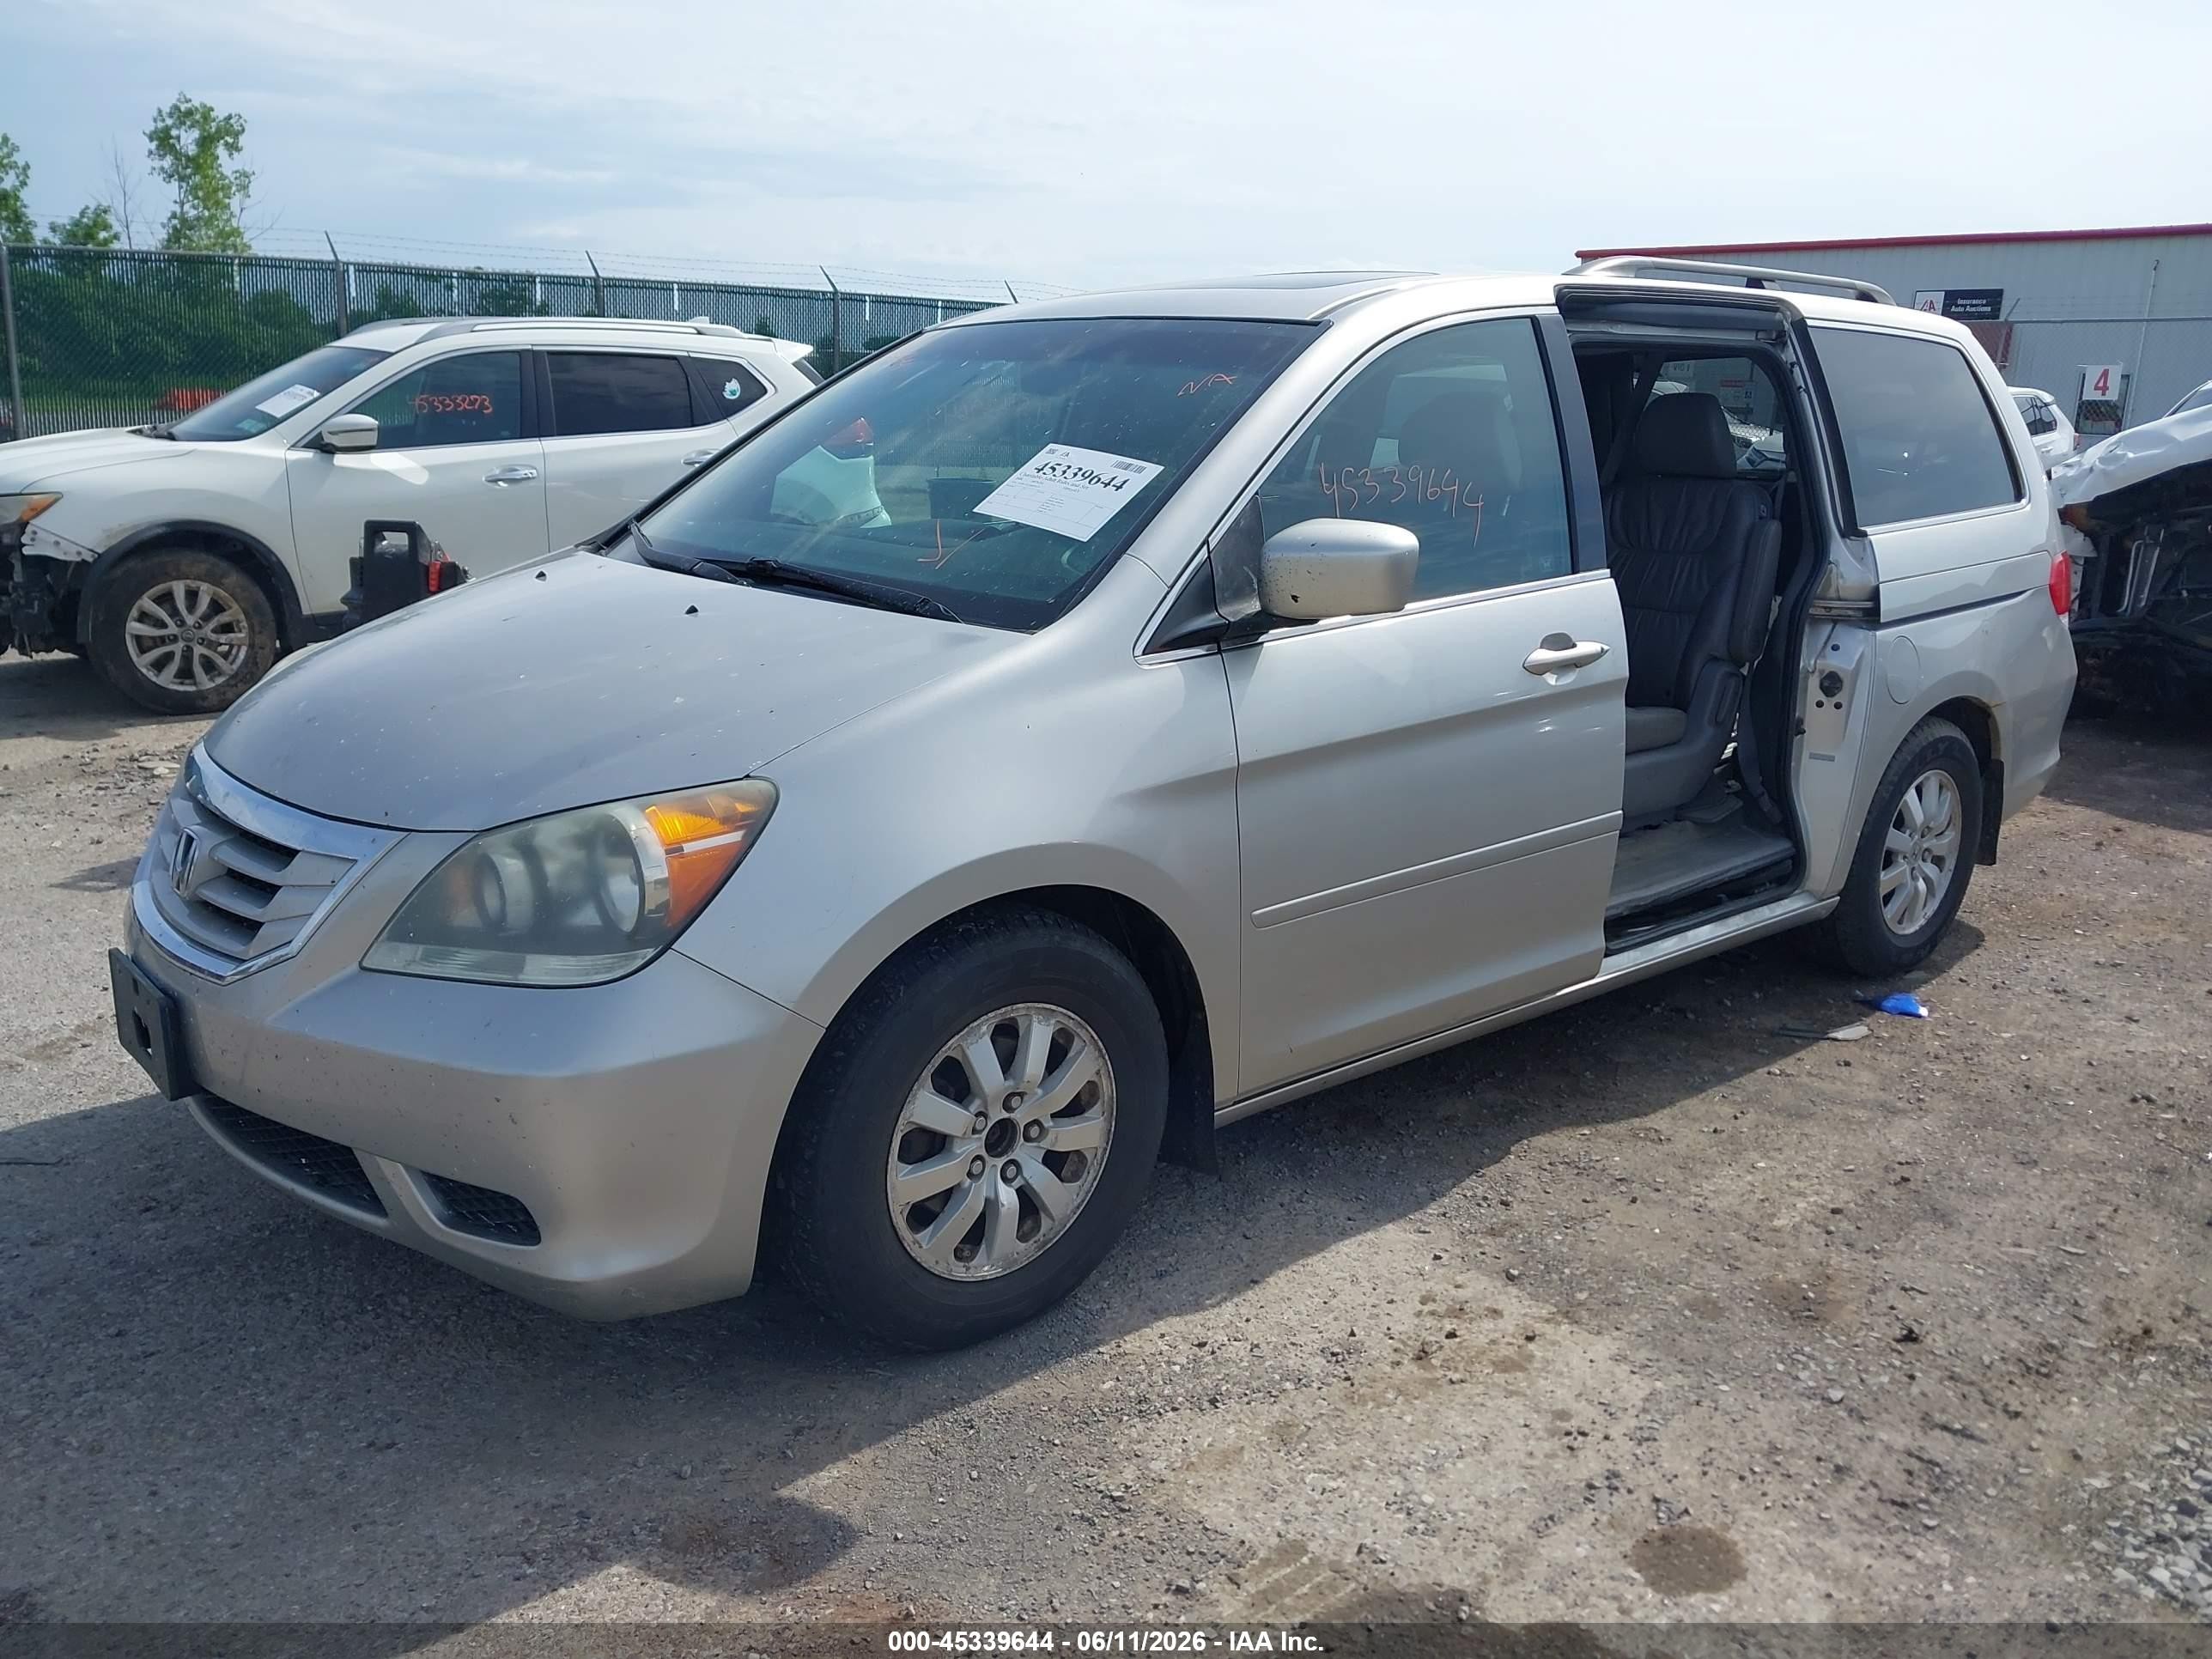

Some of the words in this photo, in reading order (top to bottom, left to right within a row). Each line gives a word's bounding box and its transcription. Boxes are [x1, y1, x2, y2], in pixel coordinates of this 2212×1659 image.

[2094, 368, 2110, 397] 4
[1034, 460, 1130, 492] 45339644
[1319, 462, 1484, 549] 45339644
